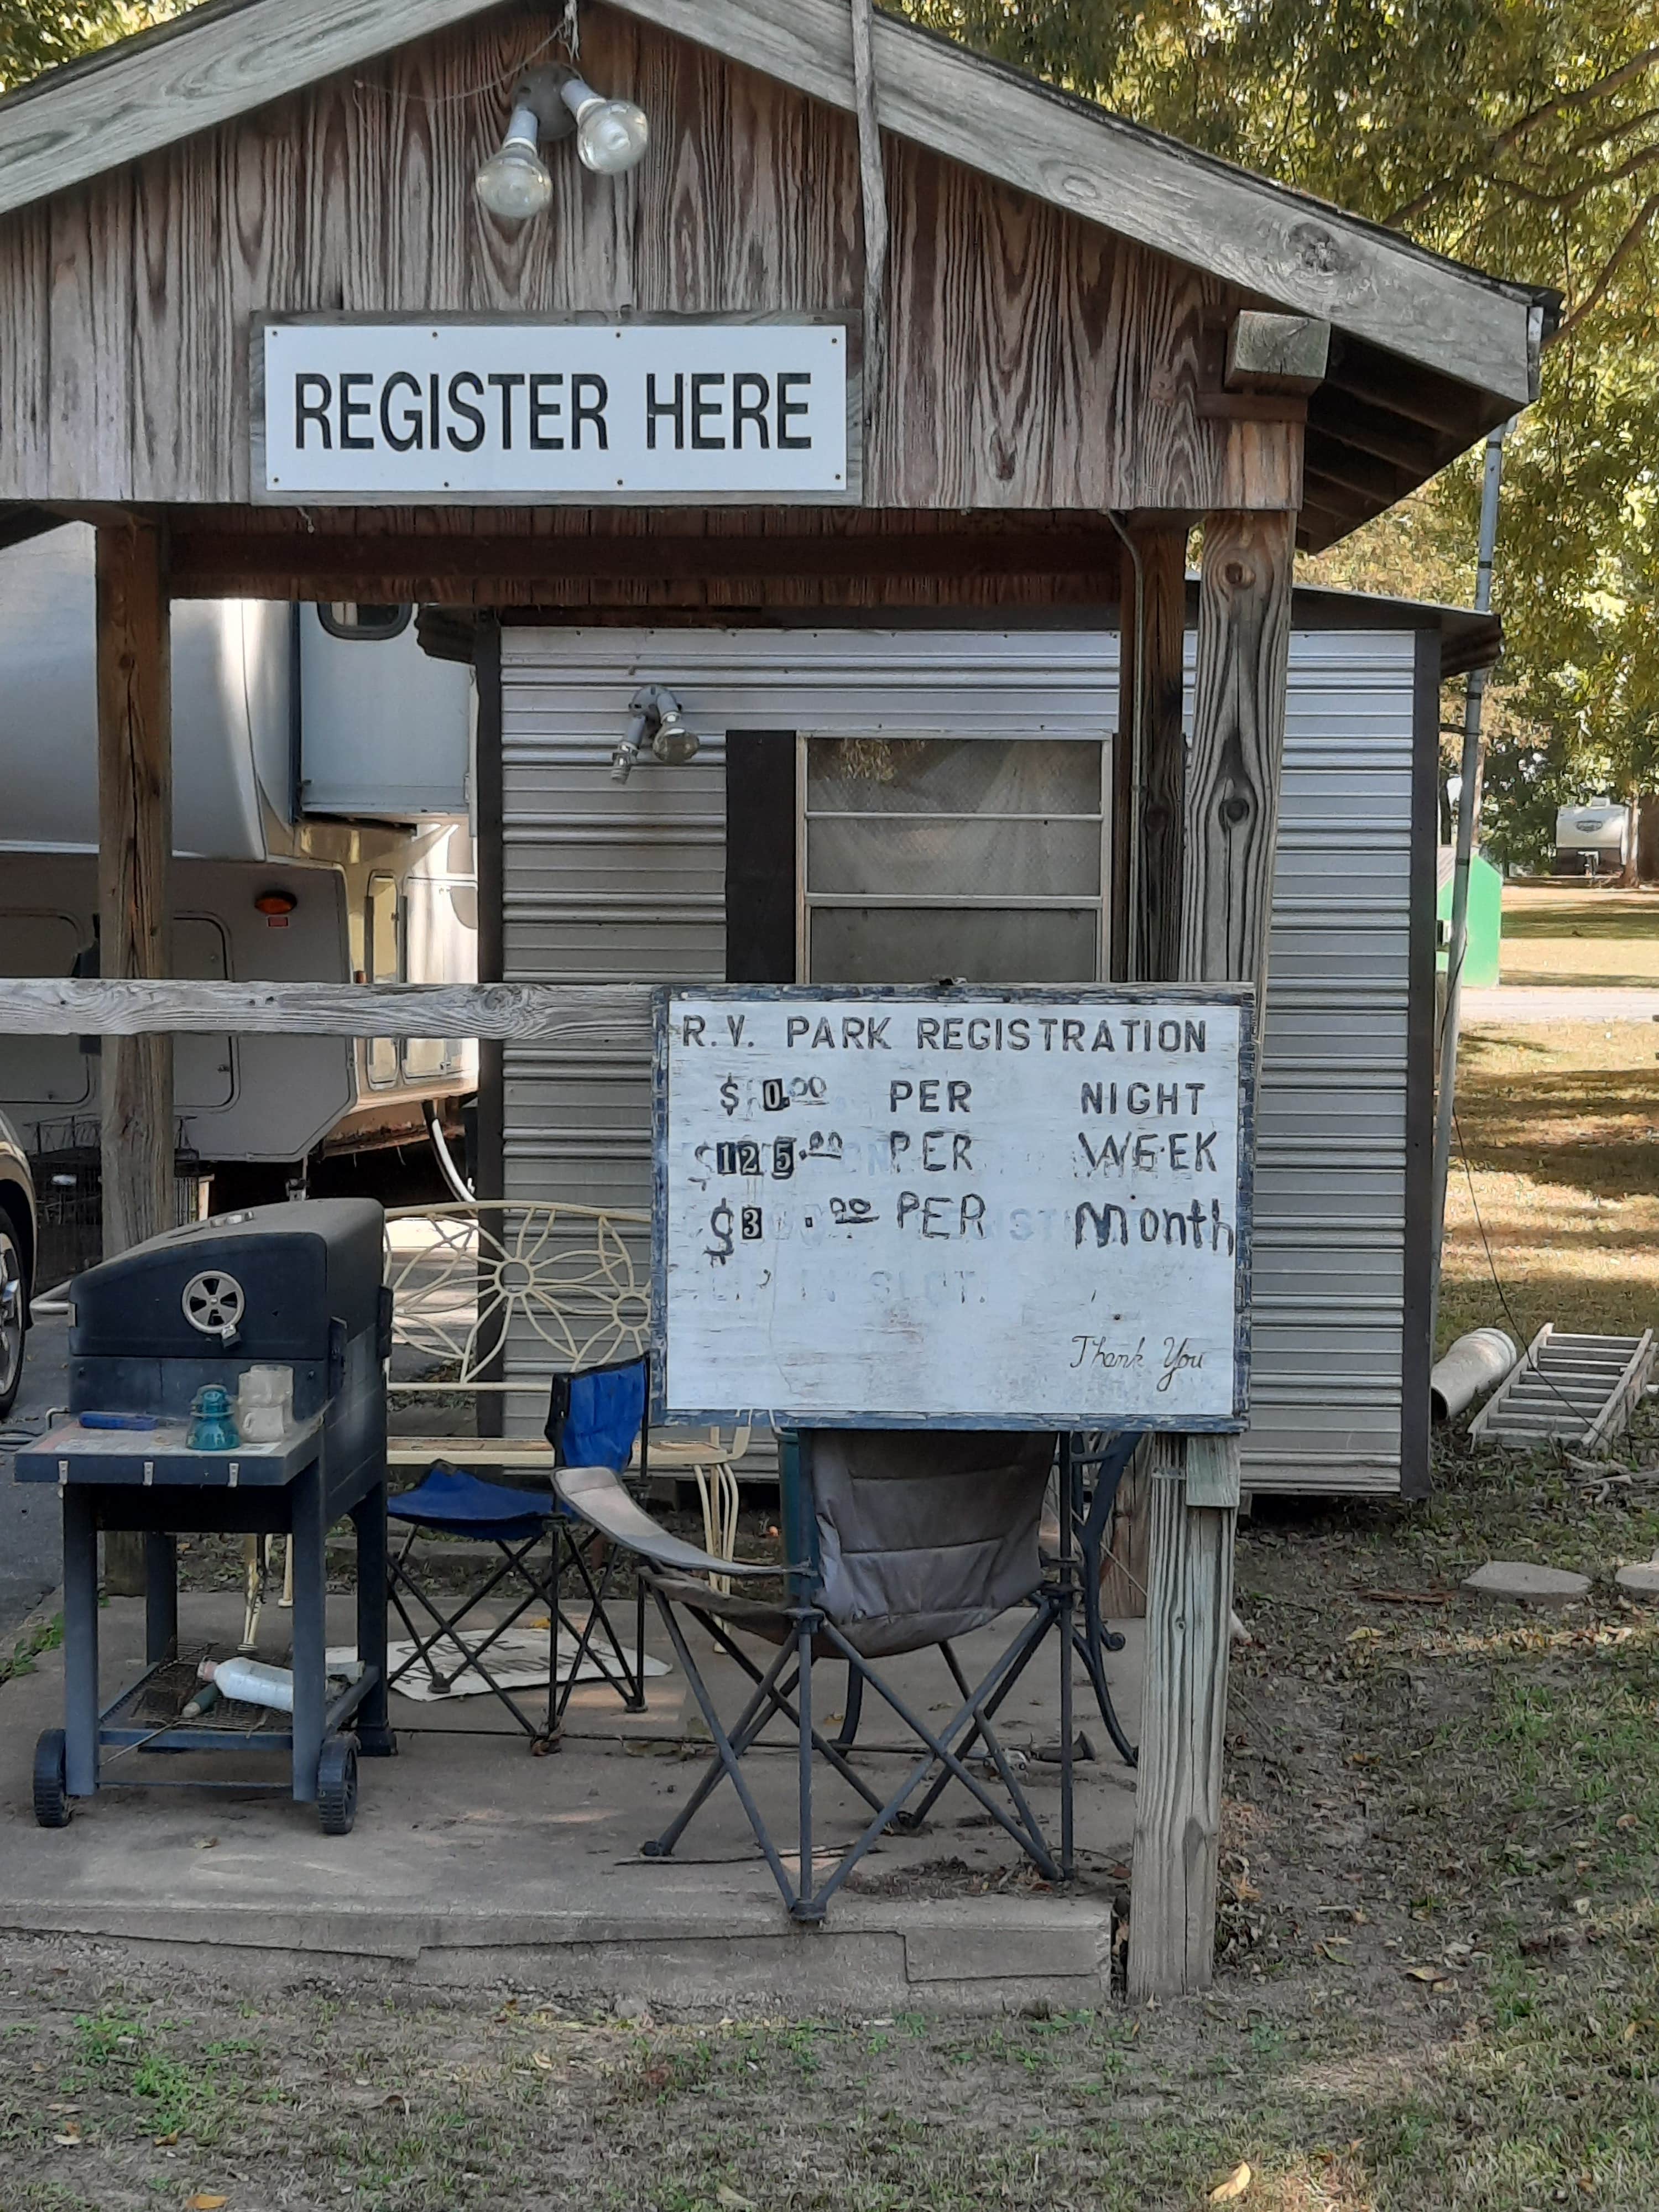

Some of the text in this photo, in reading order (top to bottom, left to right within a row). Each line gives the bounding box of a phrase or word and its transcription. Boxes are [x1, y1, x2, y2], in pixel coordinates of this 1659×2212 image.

[295, 371, 812, 452] REGISTER HERE
[682, 1014, 1206, 1053] R.V. PARK REGISTRATION
[890, 1079, 973, 1113] PER
[1081, 1082, 1206, 1115] NIGHT
[890, 1130, 973, 1172] PER
[1078, 1131, 1217, 1177] WEEK
[896, 1191, 987, 1240] PER
[1070, 1335, 1210, 1392] Thank You
